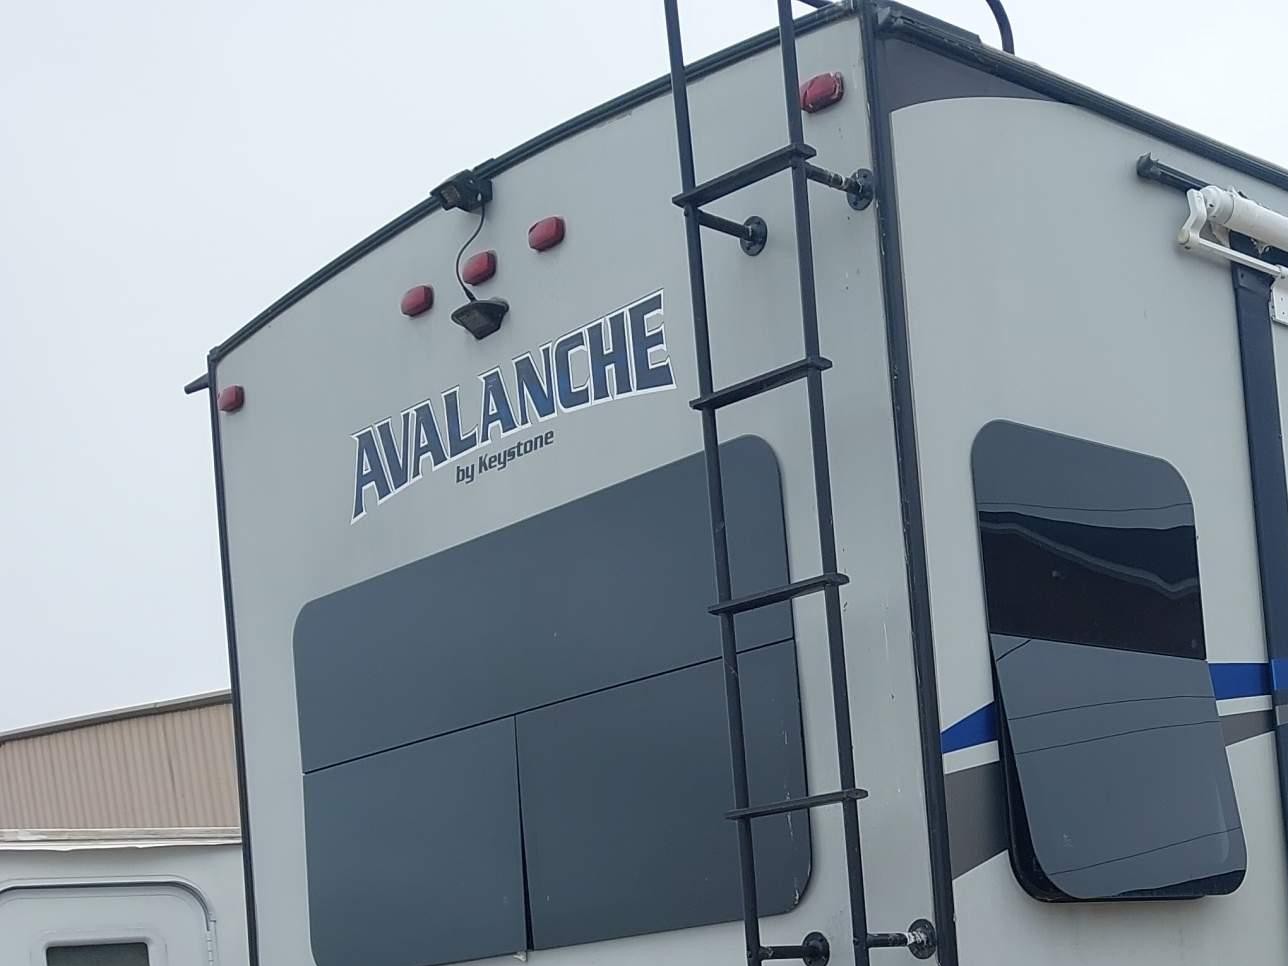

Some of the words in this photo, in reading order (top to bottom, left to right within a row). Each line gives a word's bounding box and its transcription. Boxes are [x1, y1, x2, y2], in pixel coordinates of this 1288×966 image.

[350, 288, 676, 525] AVALANCHE
[456, 466, 475, 484] by
[478, 430, 554, 475] Keystone
